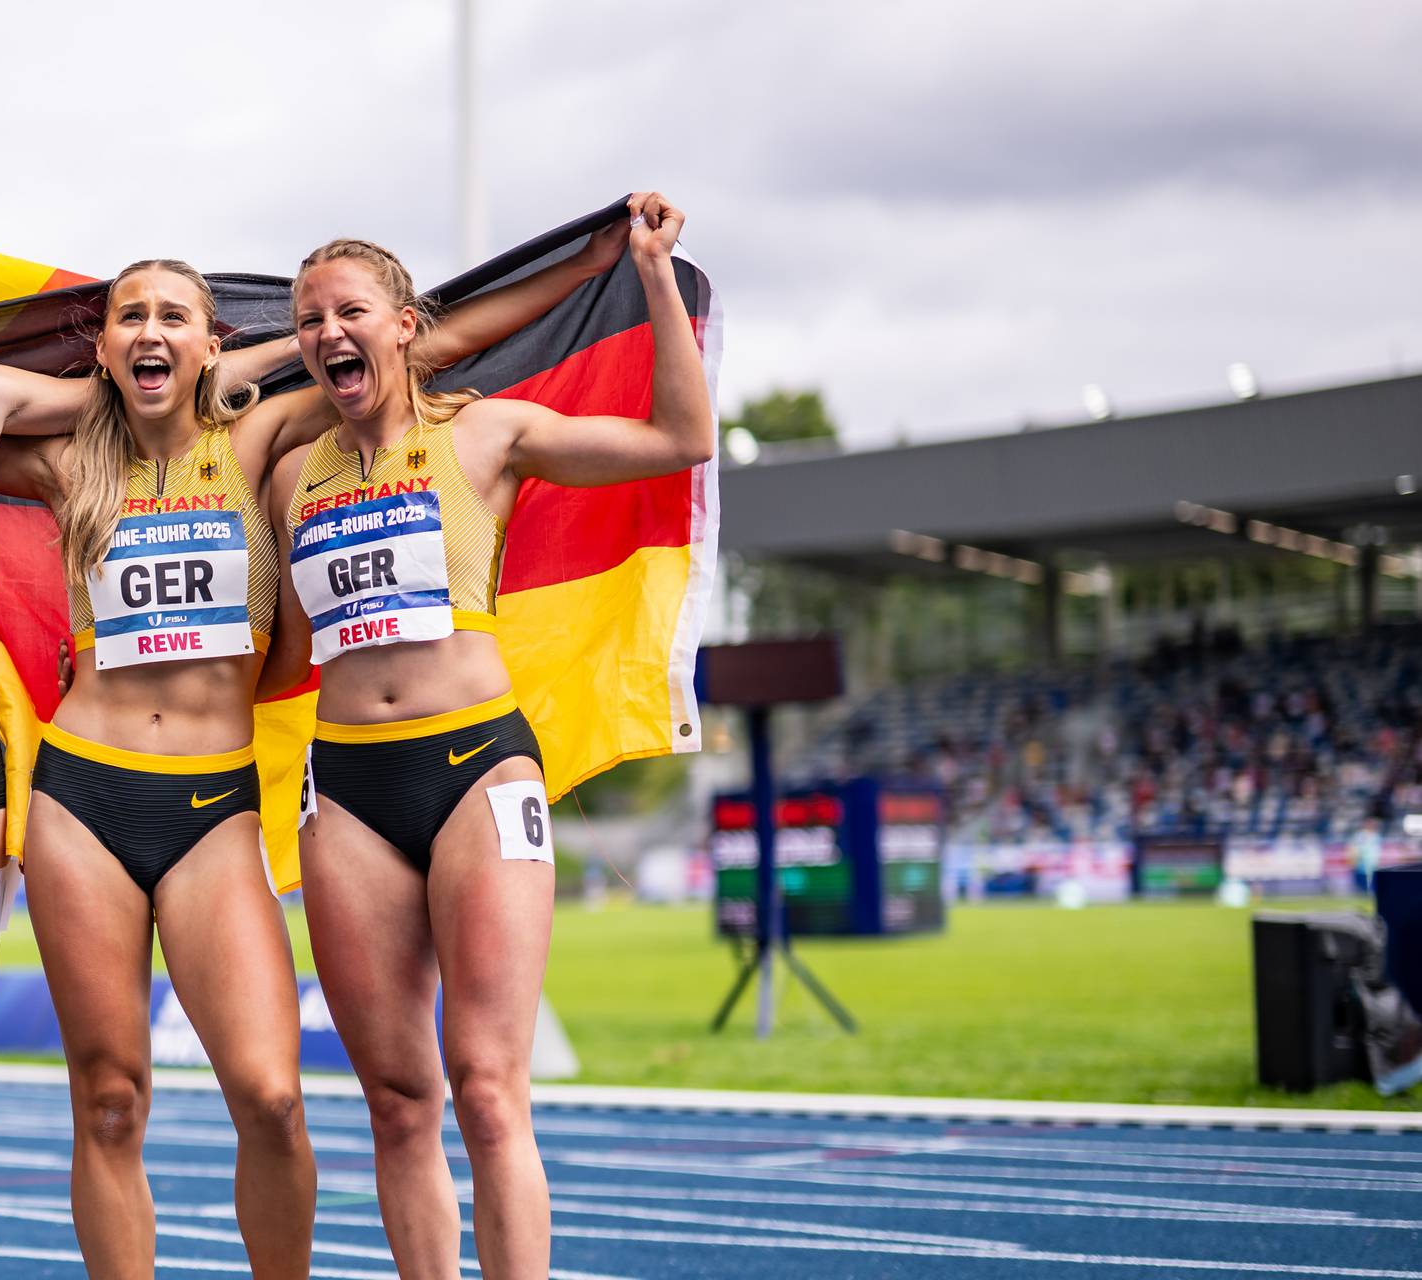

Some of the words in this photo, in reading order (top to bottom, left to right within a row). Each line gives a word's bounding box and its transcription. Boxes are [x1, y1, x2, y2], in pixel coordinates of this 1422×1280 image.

[122, 493, 227, 513] RMANY
[300, 476, 433, 521] GERMANY
[386, 505, 427, 526] 2025
[110, 523, 190, 548] INE-RUHR
[193, 522, 231, 540] 2025
[120, 559, 214, 609] GER
[327, 548, 398, 598] GER
[165, 615, 187, 624] FISU
[339, 617, 401, 648] REWE
[137, 631, 203, 655] REWE
[521, 796, 544, 848] 6
